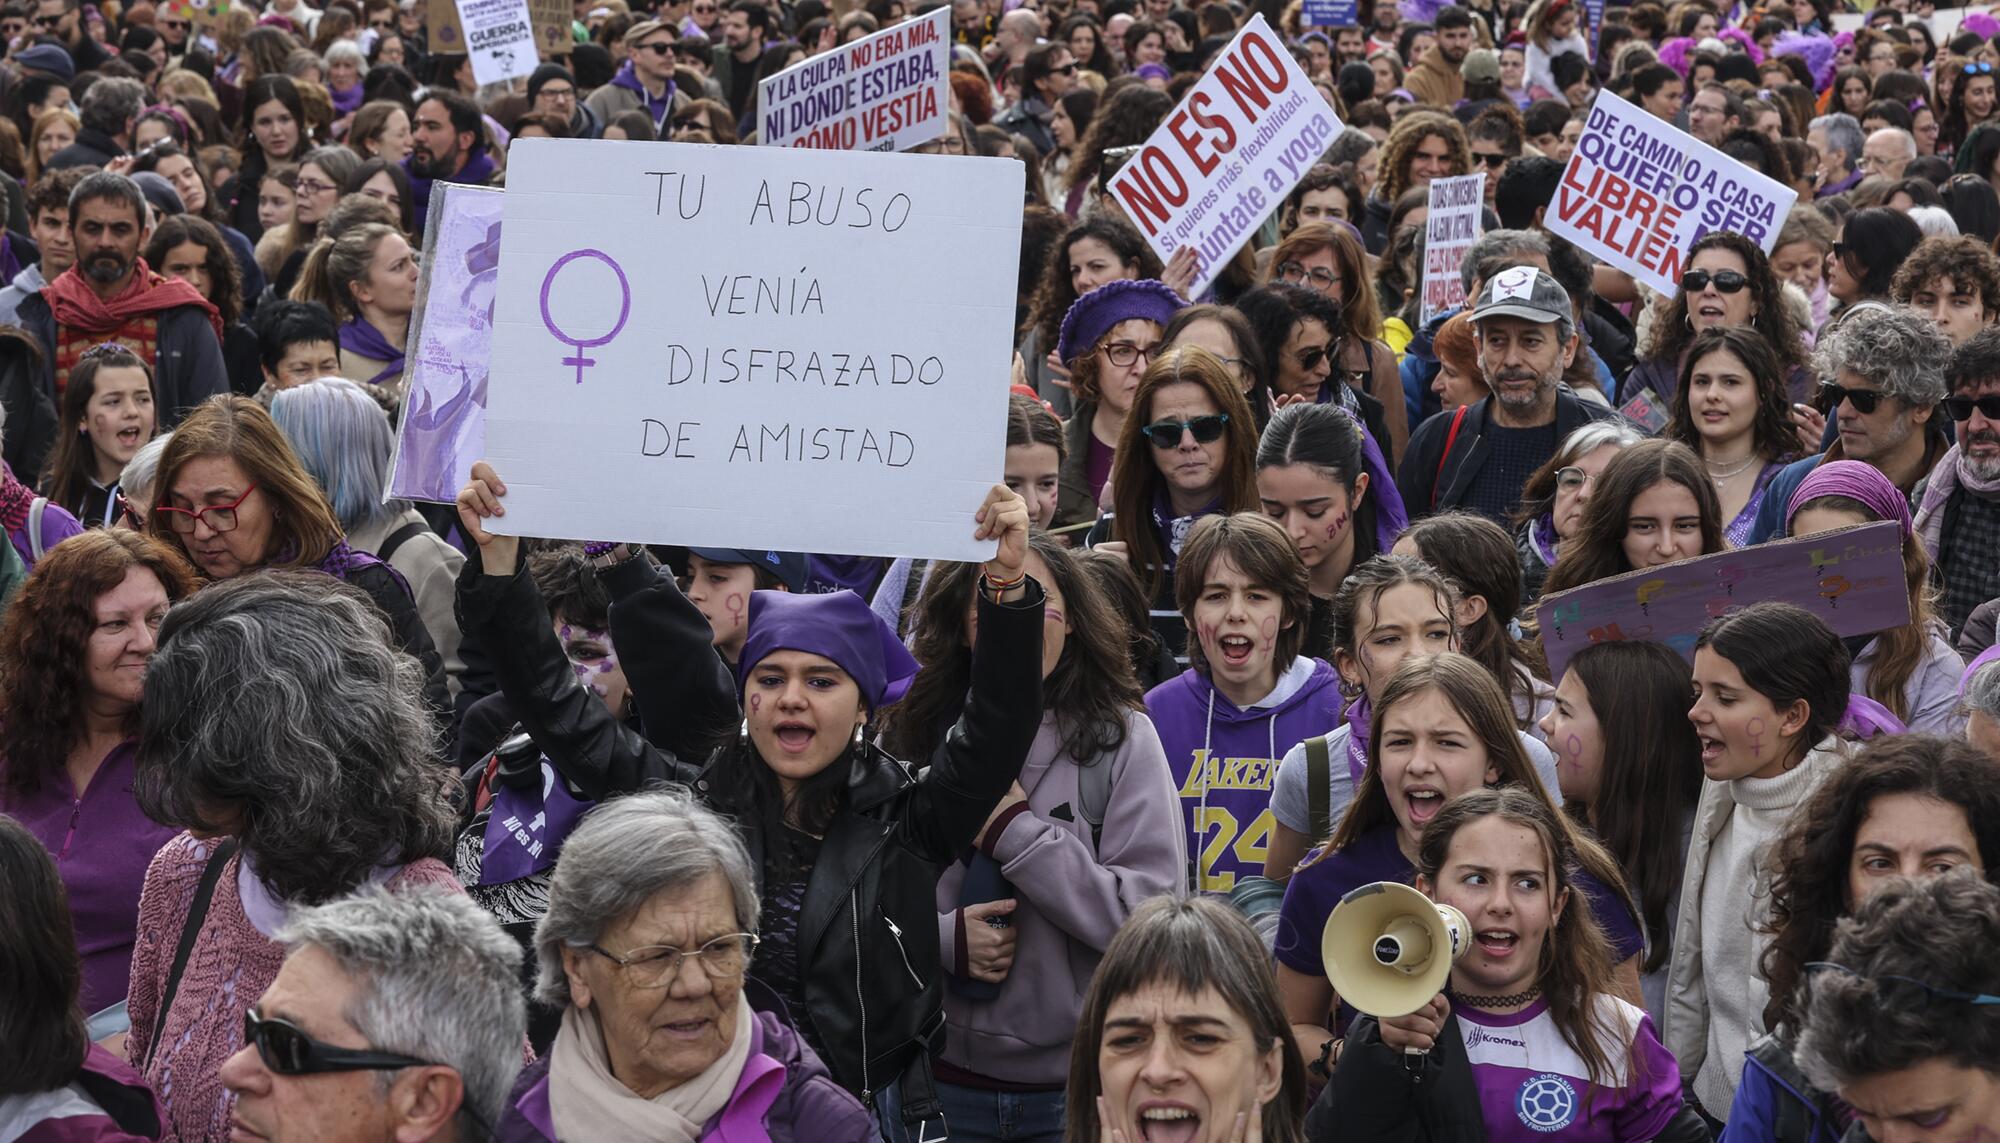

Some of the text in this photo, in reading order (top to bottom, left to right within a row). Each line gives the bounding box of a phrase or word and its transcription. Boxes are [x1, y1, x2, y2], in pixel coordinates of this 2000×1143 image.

[470, 21, 528, 43] GUERRA
[767, 19, 940, 106] Y LA CULPA NO ERA MÍA,
[766, 50, 939, 144] NI DÓNDE ESTABA,
[862, 84, 938, 143] VESTÍA
[1115, 32, 1289, 237] NO ES NO
[1587, 106, 1776, 226] DE CAMINO A CASA
[644, 172, 911, 232] TU ABUSO
[1160, 90, 1308, 253] Si quieres más flexibilidad,
[1189, 113, 1333, 287] púntate a yoga
[1564, 155, 1682, 244] LIBRE,
[1579, 132, 1699, 211] QUIERO
[1701, 199, 1768, 246] SER
[1558, 186, 1689, 285] VALIEN
[701, 266, 824, 317] VENÍA
[667, 344, 944, 386] DISFRAZADO
[641, 418, 915, 467] DE AMISTAD
[515, 828, 530, 846] es
[527, 839, 543, 860] N
[1193, 806, 1278, 893] 24
[1482, 1033, 1526, 1048] Kromex
[1523, 1073, 1576, 1096] C.D. ORCASUR
[1527, 1118, 1570, 1132] FRONTERAS
